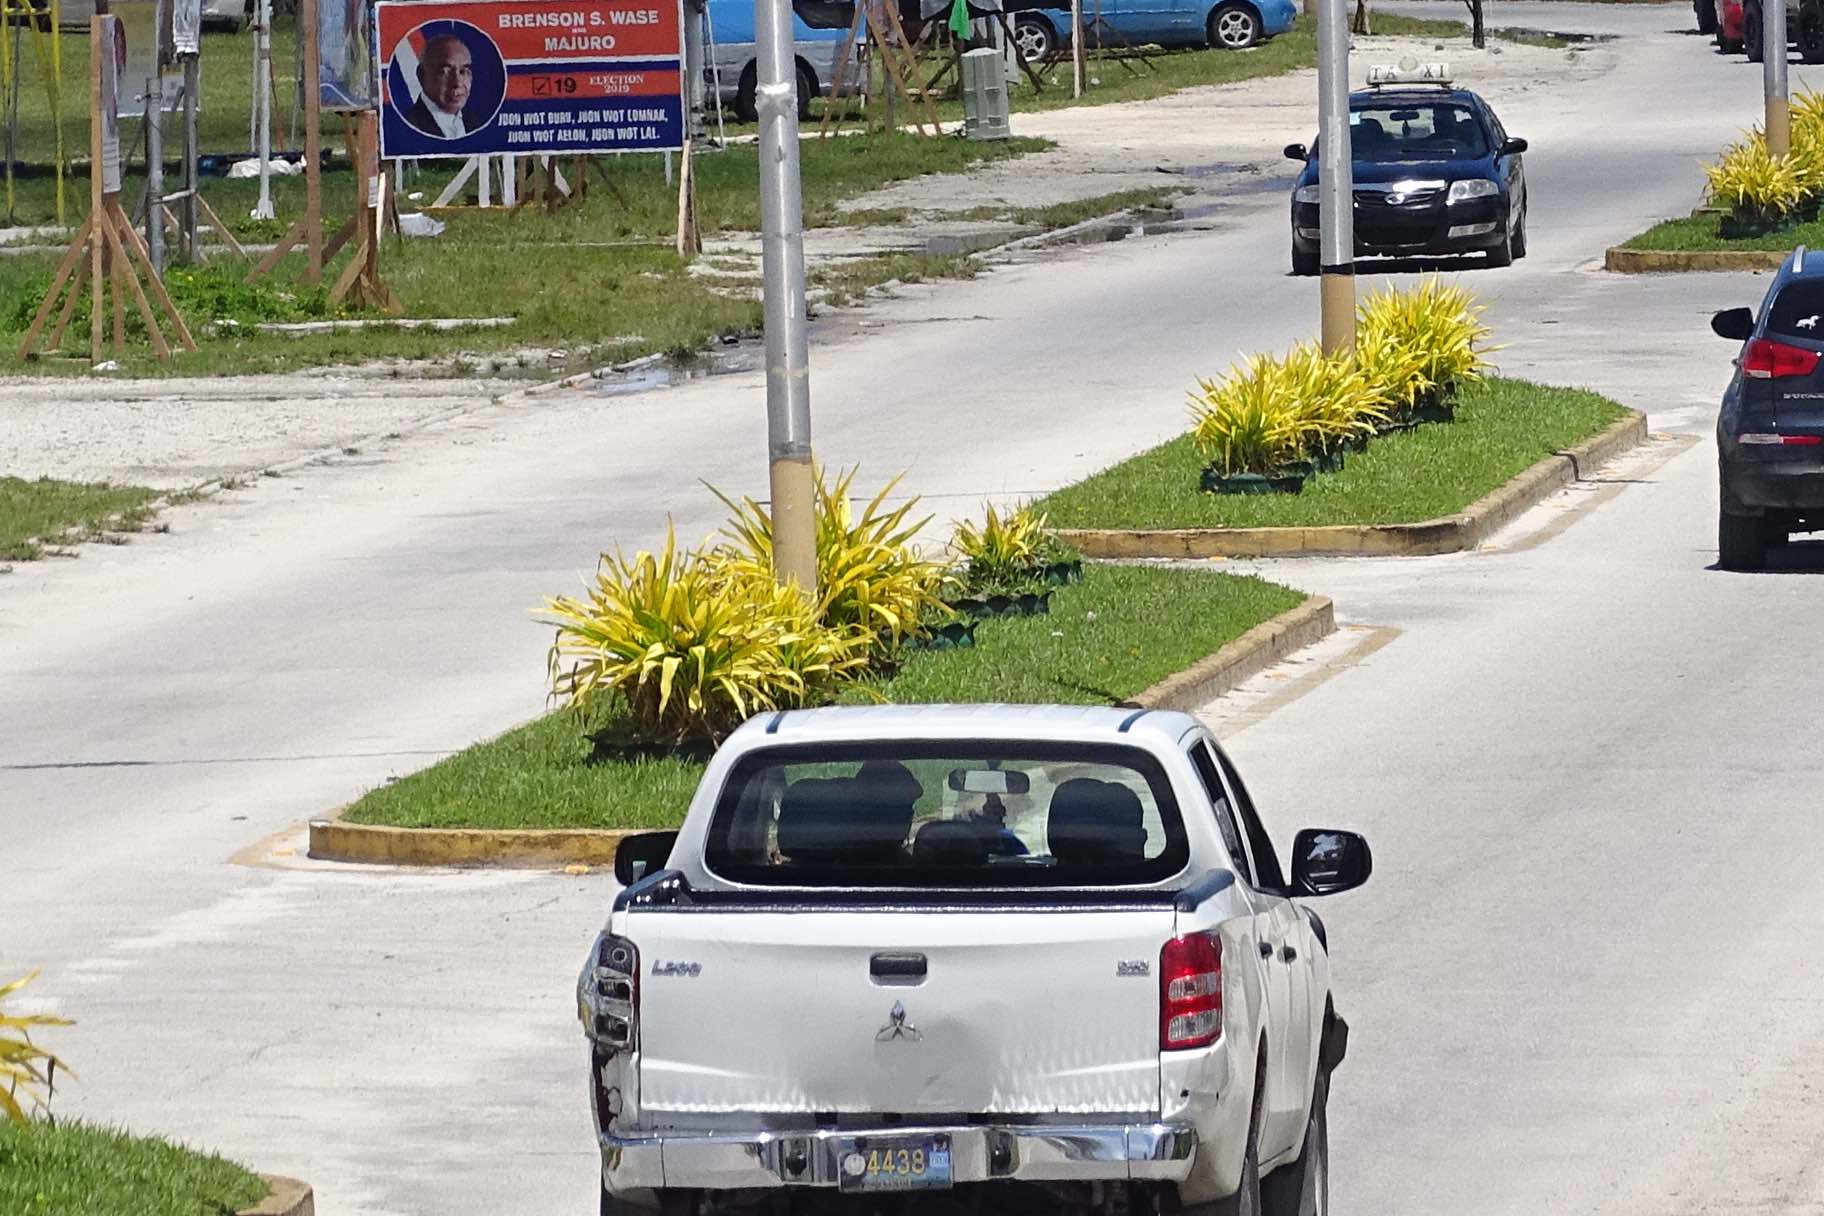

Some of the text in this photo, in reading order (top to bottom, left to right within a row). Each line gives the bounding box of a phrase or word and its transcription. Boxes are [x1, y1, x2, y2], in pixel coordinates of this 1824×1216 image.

[499, 10, 659, 29] BRENSON S. WASE
[544, 35, 615, 51] MAJURO
[589, 74, 644, 86] ELECTION
[1373, 64, 1445, 80] TAXI
[554, 77, 576, 94] 19
[604, 83, 630, 94] 2019
[498, 111, 521, 126] JUON
[523, 110, 545, 125] WOT
[577, 110, 600, 124] JUON
[602, 109, 625, 123] WOT
[507, 131, 531, 144] JUON
[533, 130, 555, 143] WOT
[591, 129, 615, 142] JUON
[616, 127, 639, 141] WOT
[866, 1148, 925, 1176] 4438
